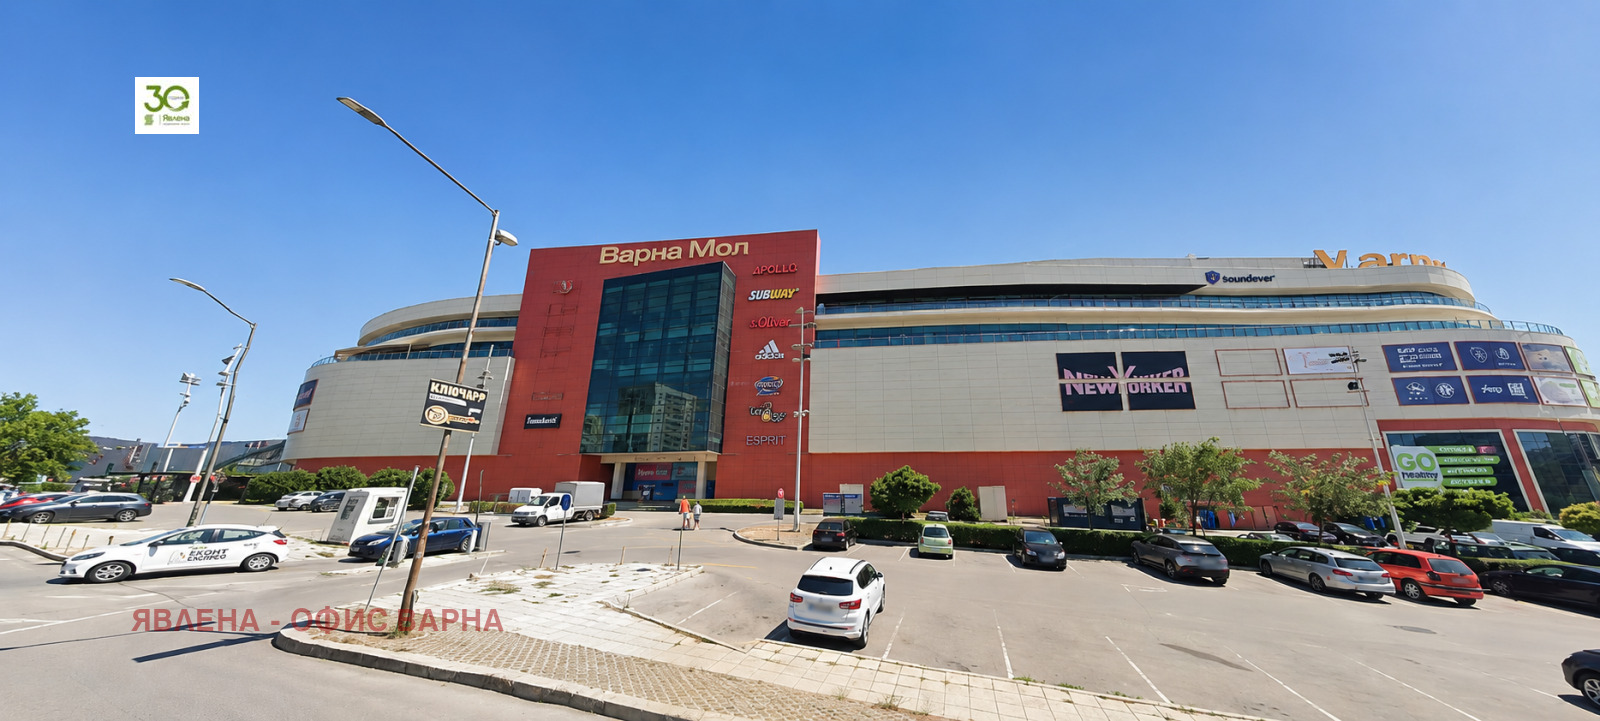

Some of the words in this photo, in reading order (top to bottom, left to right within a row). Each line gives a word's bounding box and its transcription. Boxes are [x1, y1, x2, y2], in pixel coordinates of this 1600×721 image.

[599, 246, 683, 266] Варна
[688, 239, 749, 258] Мол
[752, 262, 797, 275] APOLLO
[1222, 273, 1275, 283] soundever
[748, 288, 797, 301] SUBWAY
[750, 316, 791, 328] s.Oliver
[1063, 368, 1117, 395] NEW
[1107, 365, 1188, 394] YORKER
[746, 435, 786, 446] ESPRIT
[1396, 452, 1437, 472] GO
